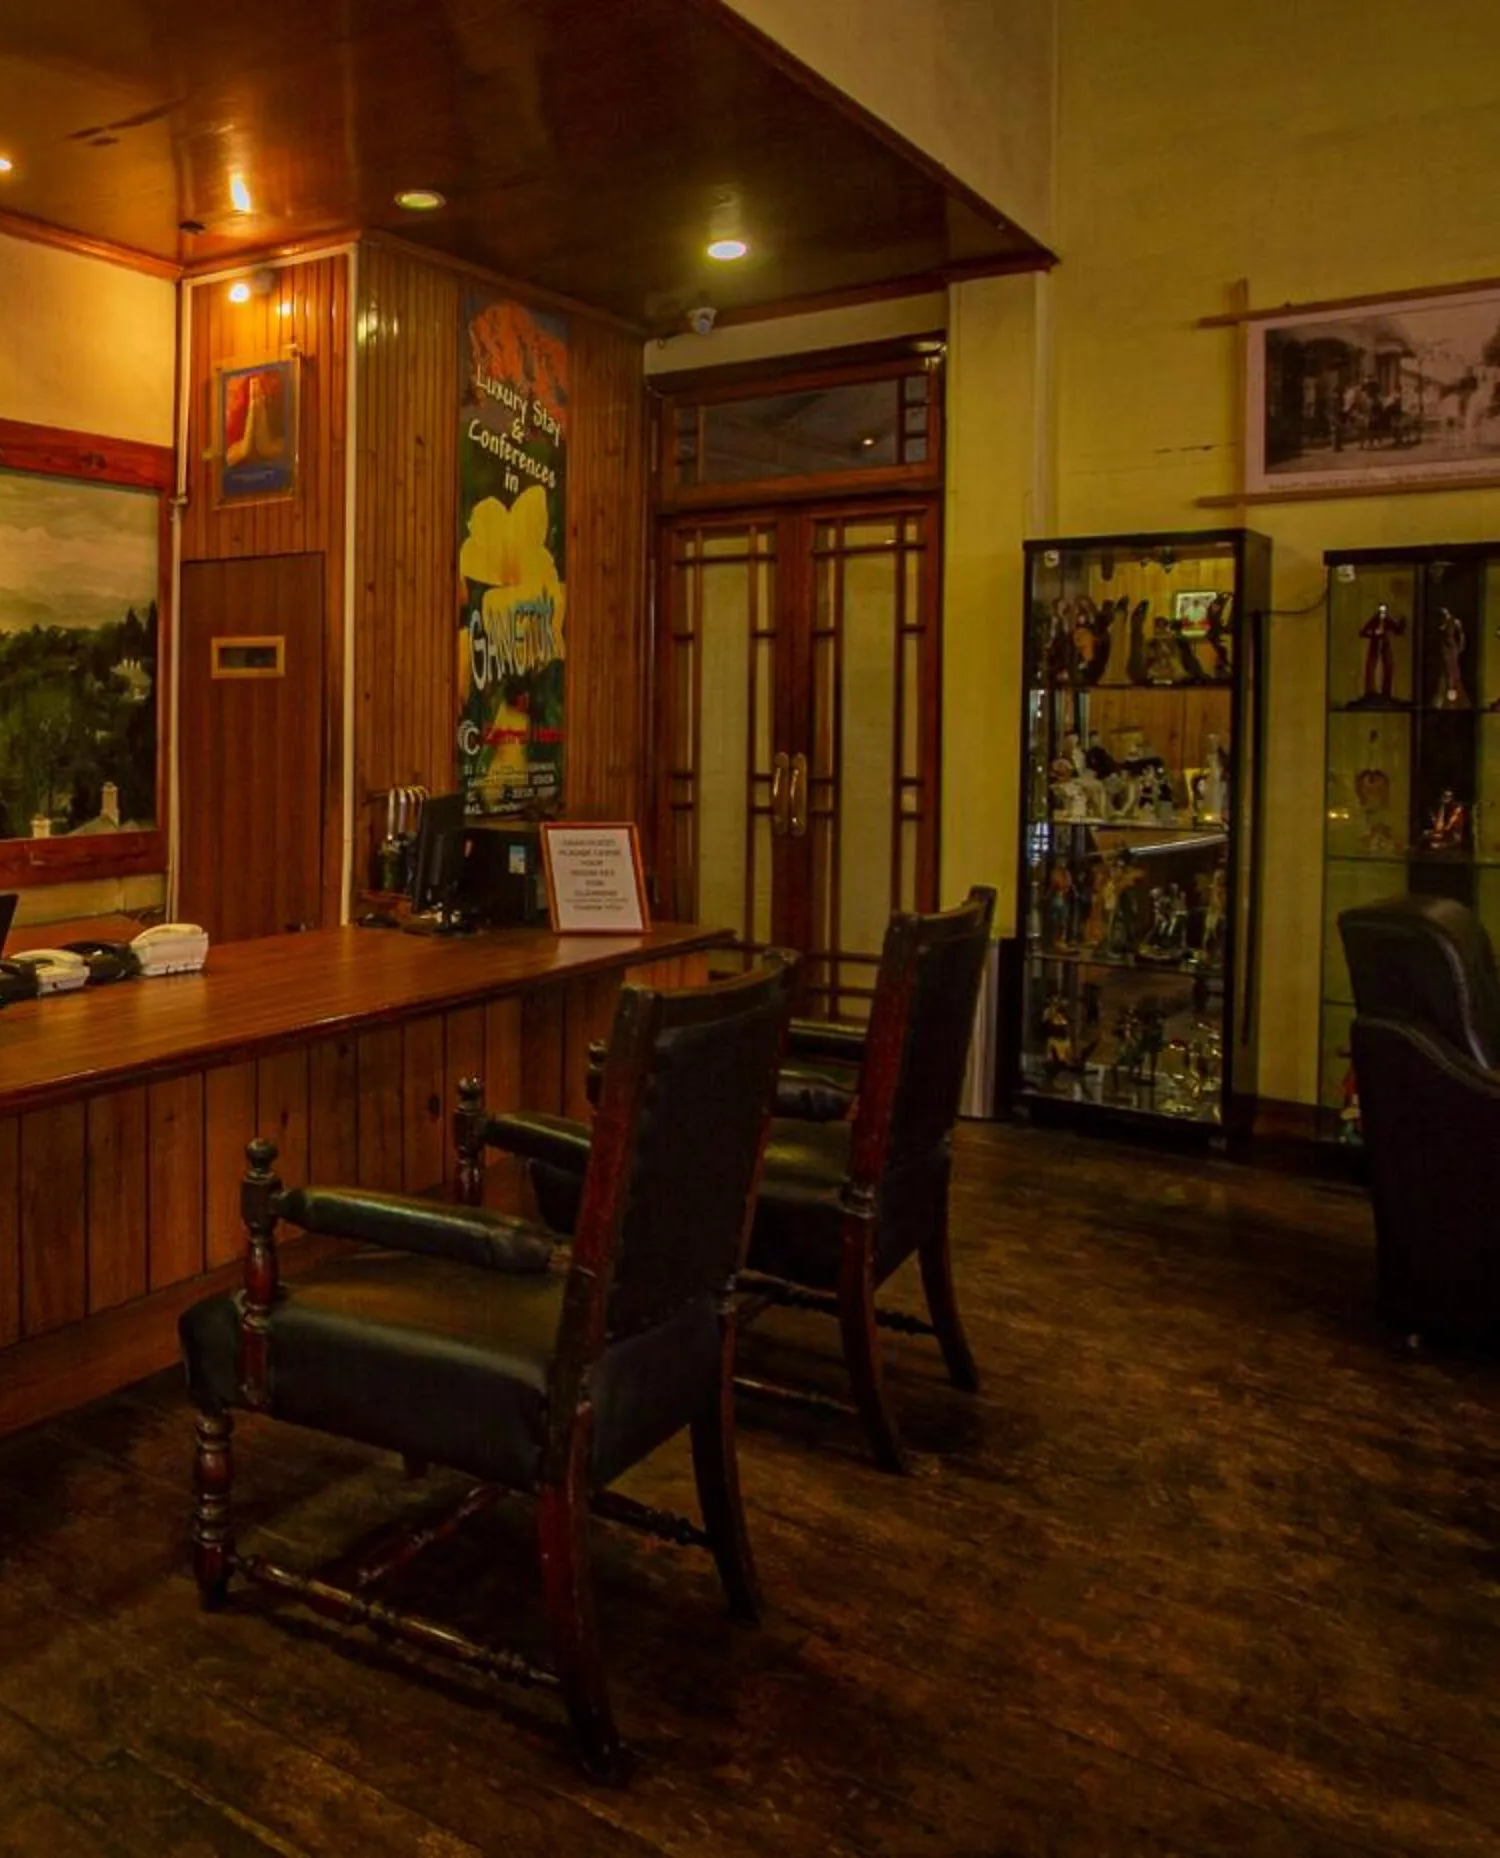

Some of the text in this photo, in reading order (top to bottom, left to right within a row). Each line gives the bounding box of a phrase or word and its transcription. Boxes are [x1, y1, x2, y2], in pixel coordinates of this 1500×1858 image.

[476, 365, 562, 448] Luxury Stay
[467, 419, 557, 489] Conferences
[511, 419, 525, 444] &
[504, 466, 520, 493] in
